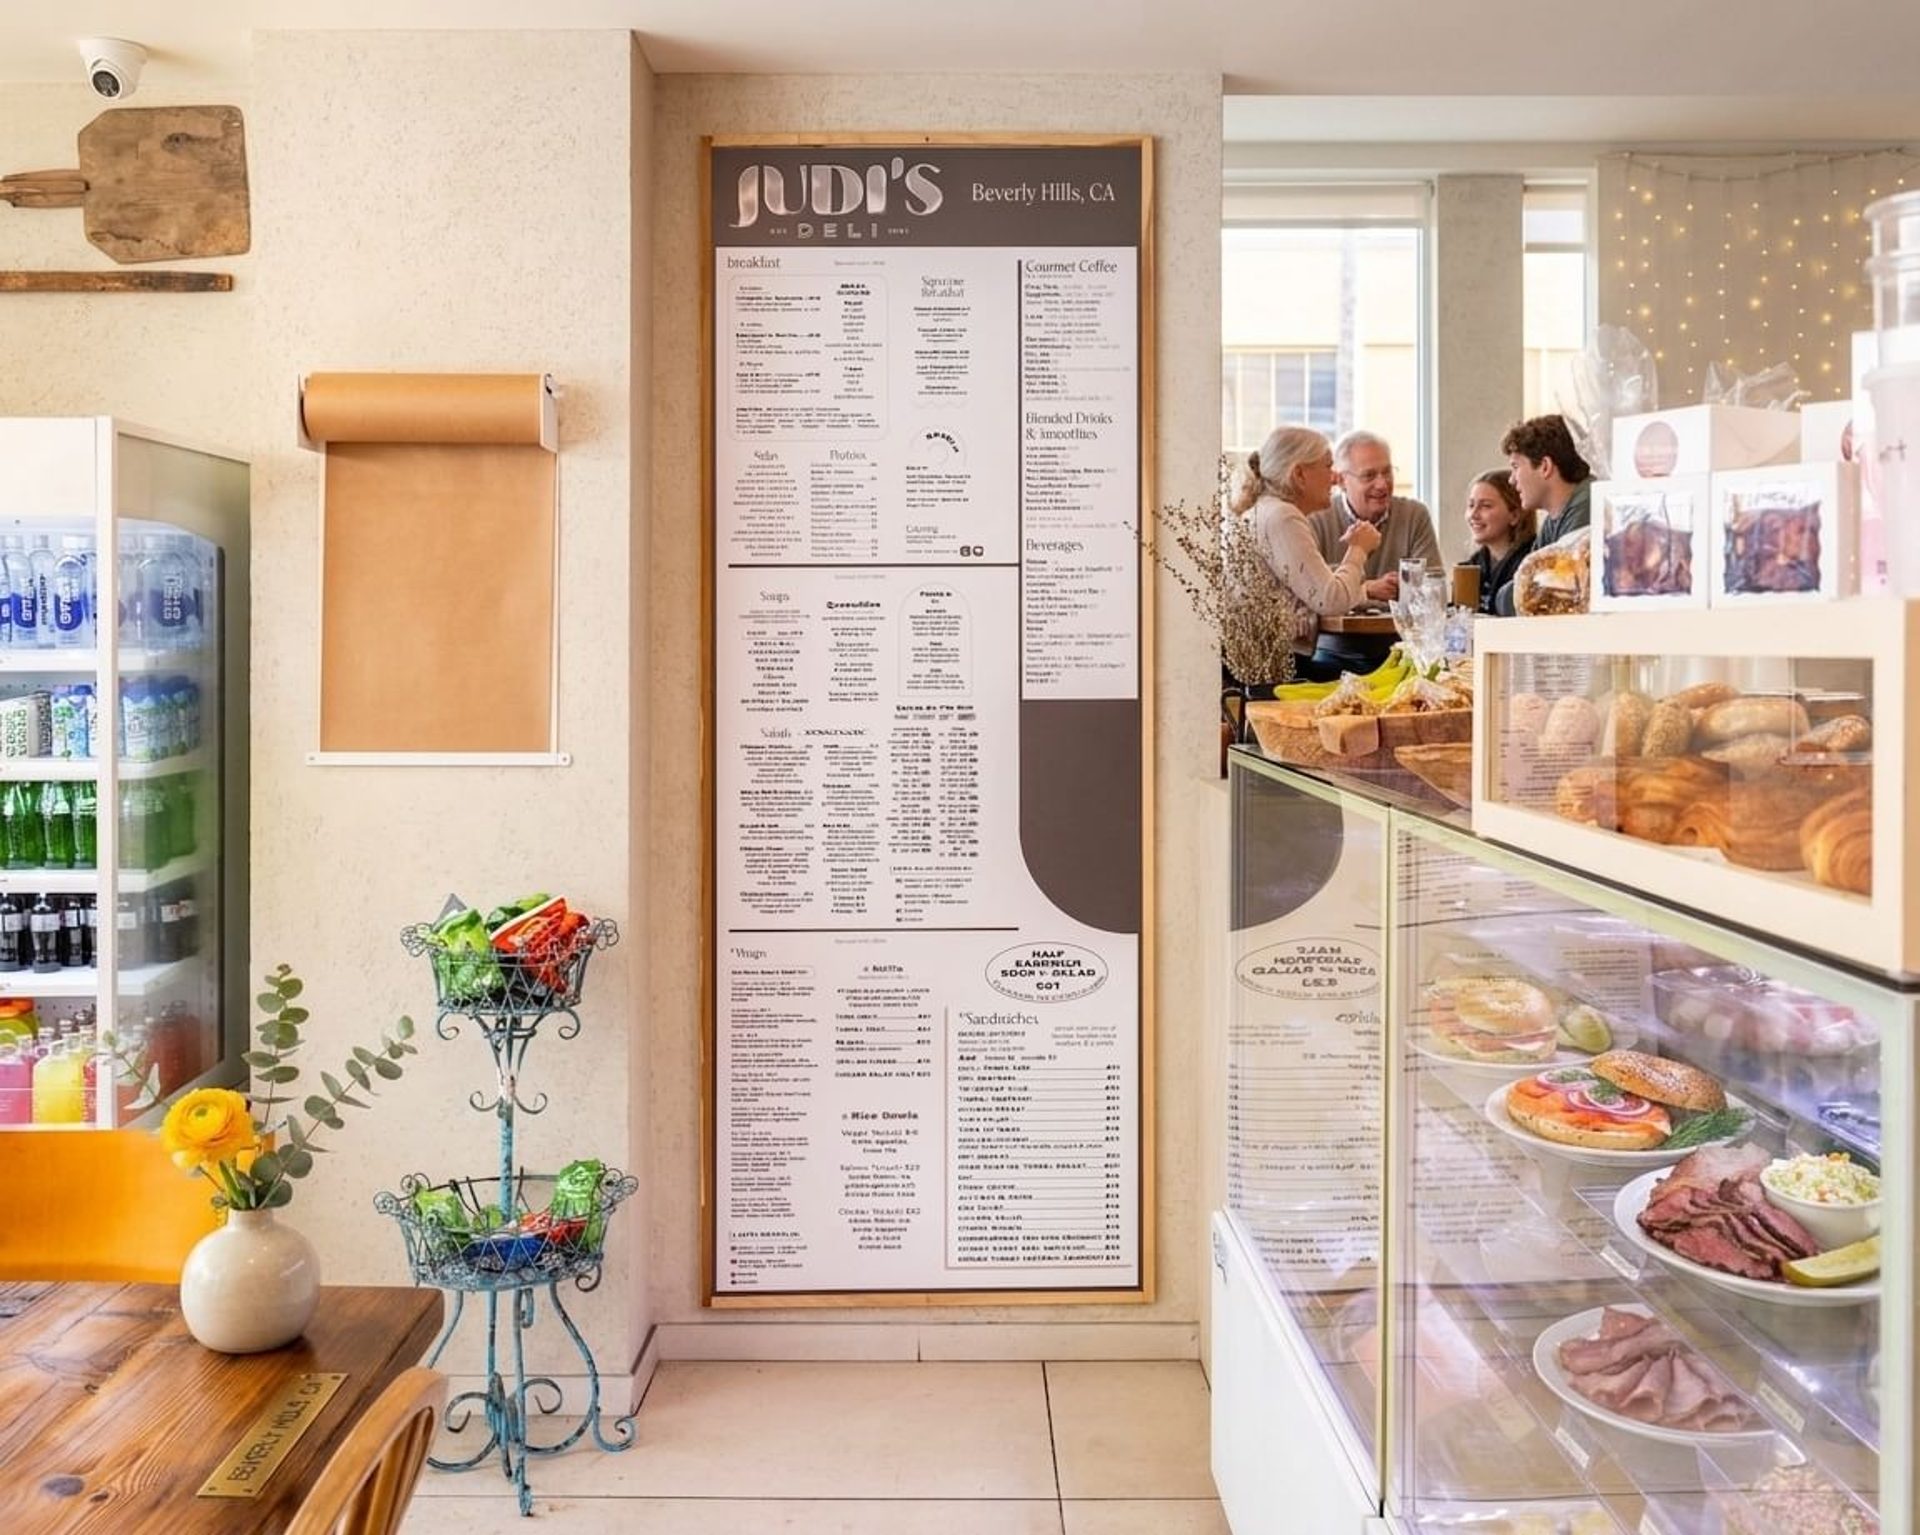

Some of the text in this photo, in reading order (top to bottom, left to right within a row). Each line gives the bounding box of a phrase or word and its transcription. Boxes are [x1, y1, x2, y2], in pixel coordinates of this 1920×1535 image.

[729, 156, 944, 228] JUDI'S
[972, 182, 1115, 206] Beverly Hills, CA
[797, 223, 878, 239] DELI
[1026, 259, 1076, 273] Gourmet
